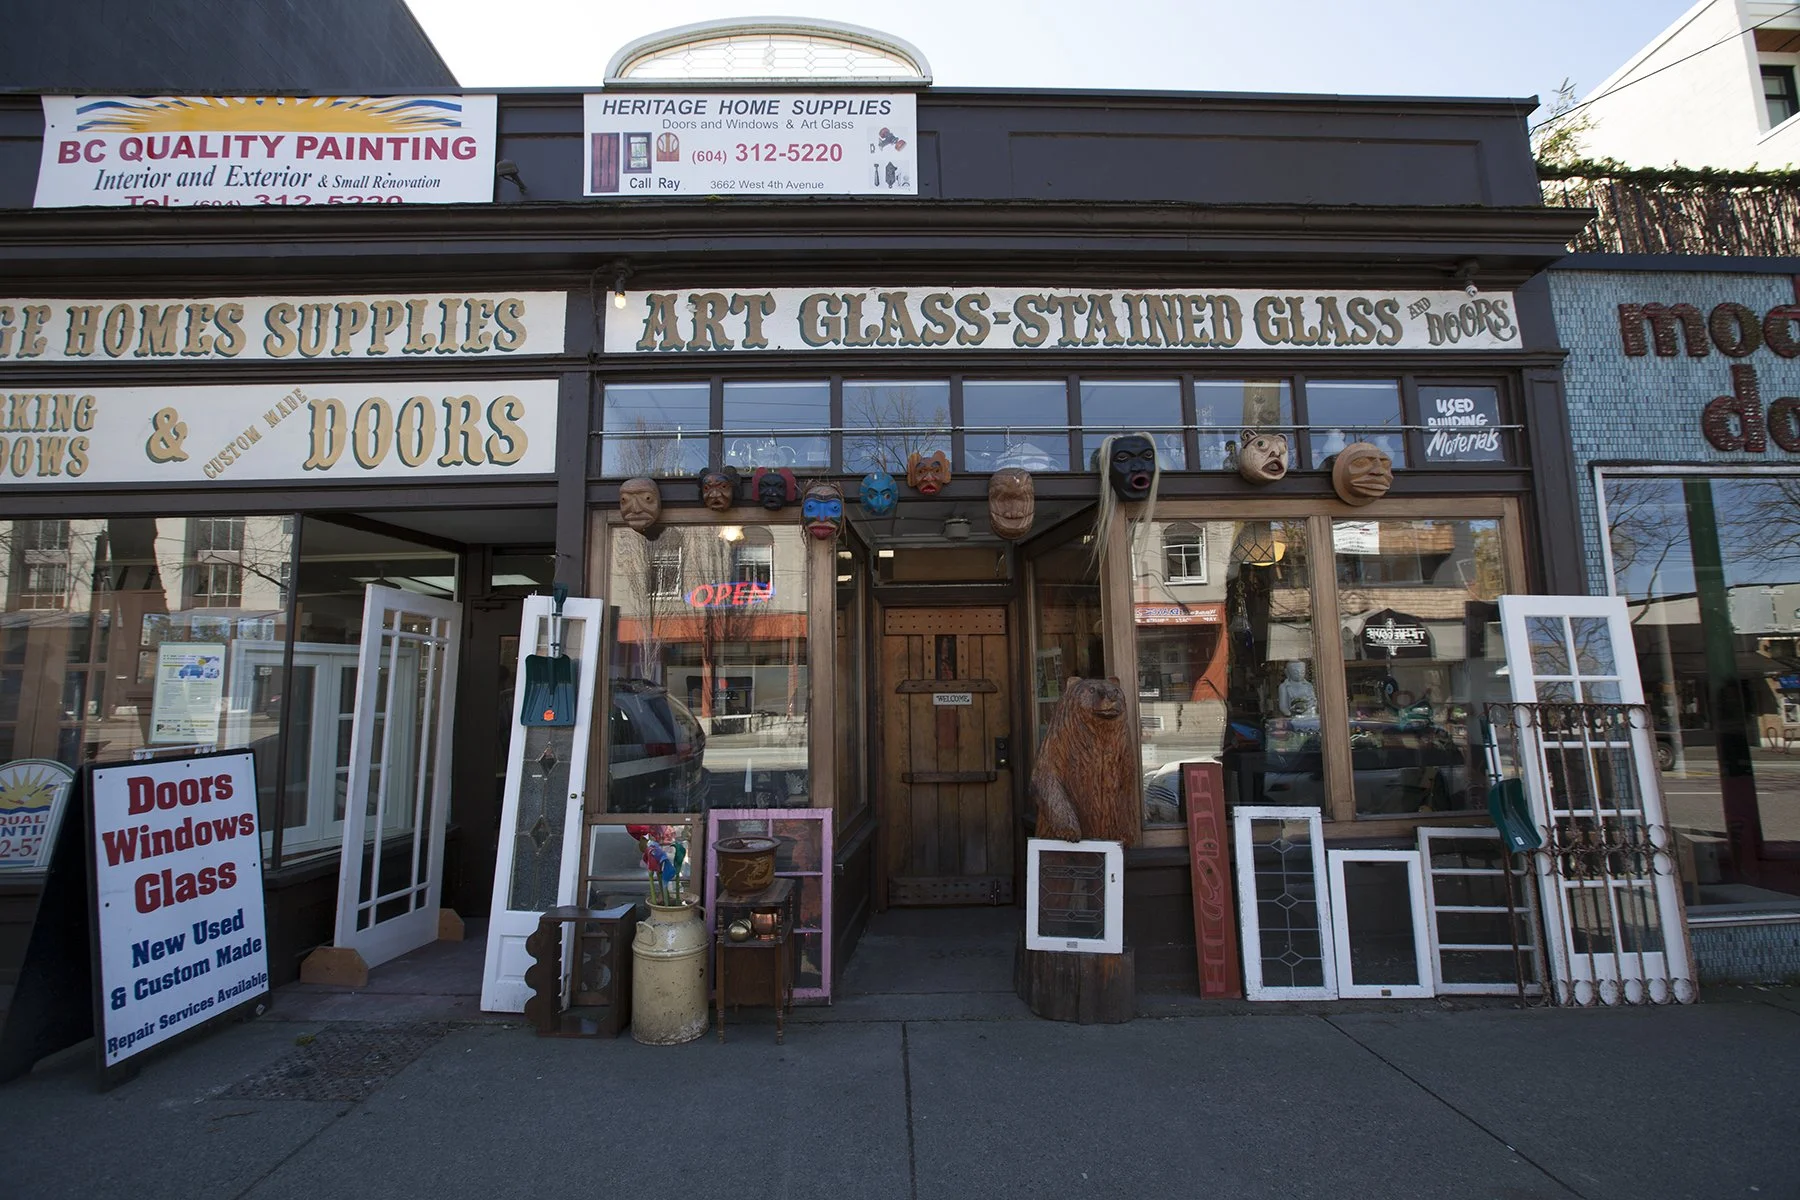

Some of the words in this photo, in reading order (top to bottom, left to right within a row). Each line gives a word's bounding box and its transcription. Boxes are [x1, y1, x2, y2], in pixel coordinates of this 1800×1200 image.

[602, 99, 707, 116] HERITAGE
[719, 99, 781, 116] HOME
[791, 99, 892, 116] SUPPLIES
[662, 119, 698, 130] Doors
[700, 119, 723, 130] and
[726, 119, 779, 130] Windows
[785, 119, 794, 129] &
[800, 119, 818, 130] Art
[821, 119, 854, 130] Glass
[58, 139, 107, 164] BC
[120, 135, 285, 163] QUALITY
[296, 135, 477, 161] PAINTING
[691, 150, 728, 165] (604)
[735, 143, 844, 163] 312-5220
[93, 165, 171, 191] Interior
[176, 165, 214, 187] and
[224, 164, 313, 188] Exterior
[318, 174, 328, 188] &
[333, 174, 370, 188] Small
[373, 174, 441, 189] Renovation
[629, 177, 652, 190] Call
[658, 177, 681, 192] Ray
[710, 180, 735, 190] 3662
[738, 180, 764, 189] West
[767, 180, 783, 189] 4th
[785, 180, 825, 189] Avenue
[64, 302, 247, 358] HOMES
[263, 297, 529, 358] SUPPLIES
[635, 292, 776, 351] ART
[1253, 295, 1404, 346] GLASS
[1407, 297, 1431, 320] AND
[1424, 298, 1518, 346] DOORS
[0, 393, 98, 433] KING
[1436, 398, 1475, 417] USED
[145, 406, 189, 464] &
[202, 424, 263, 480] CUSTOM
[262, 387, 308, 429] MADE
[302, 394, 529, 471] DOORS
[1427, 428, 1499, 457] Materials
[689, 581, 775, 608] OPEN
[936, 694, 970, 703] WELCOME
[127, 772, 234, 816] Doors
[102, 812, 255, 867] Windows
[134, 861, 238, 914] Glass
[131, 933, 186, 968] New
[192, 908, 245, 945] Used
[110, 986, 127, 1011] &
[134, 957, 211, 1001] Custom
[216, 937, 262, 968] Made
[107, 1022, 155, 1054] Repair
[159, 997, 214, 1030] Services
[217, 972, 268, 1004] Available
